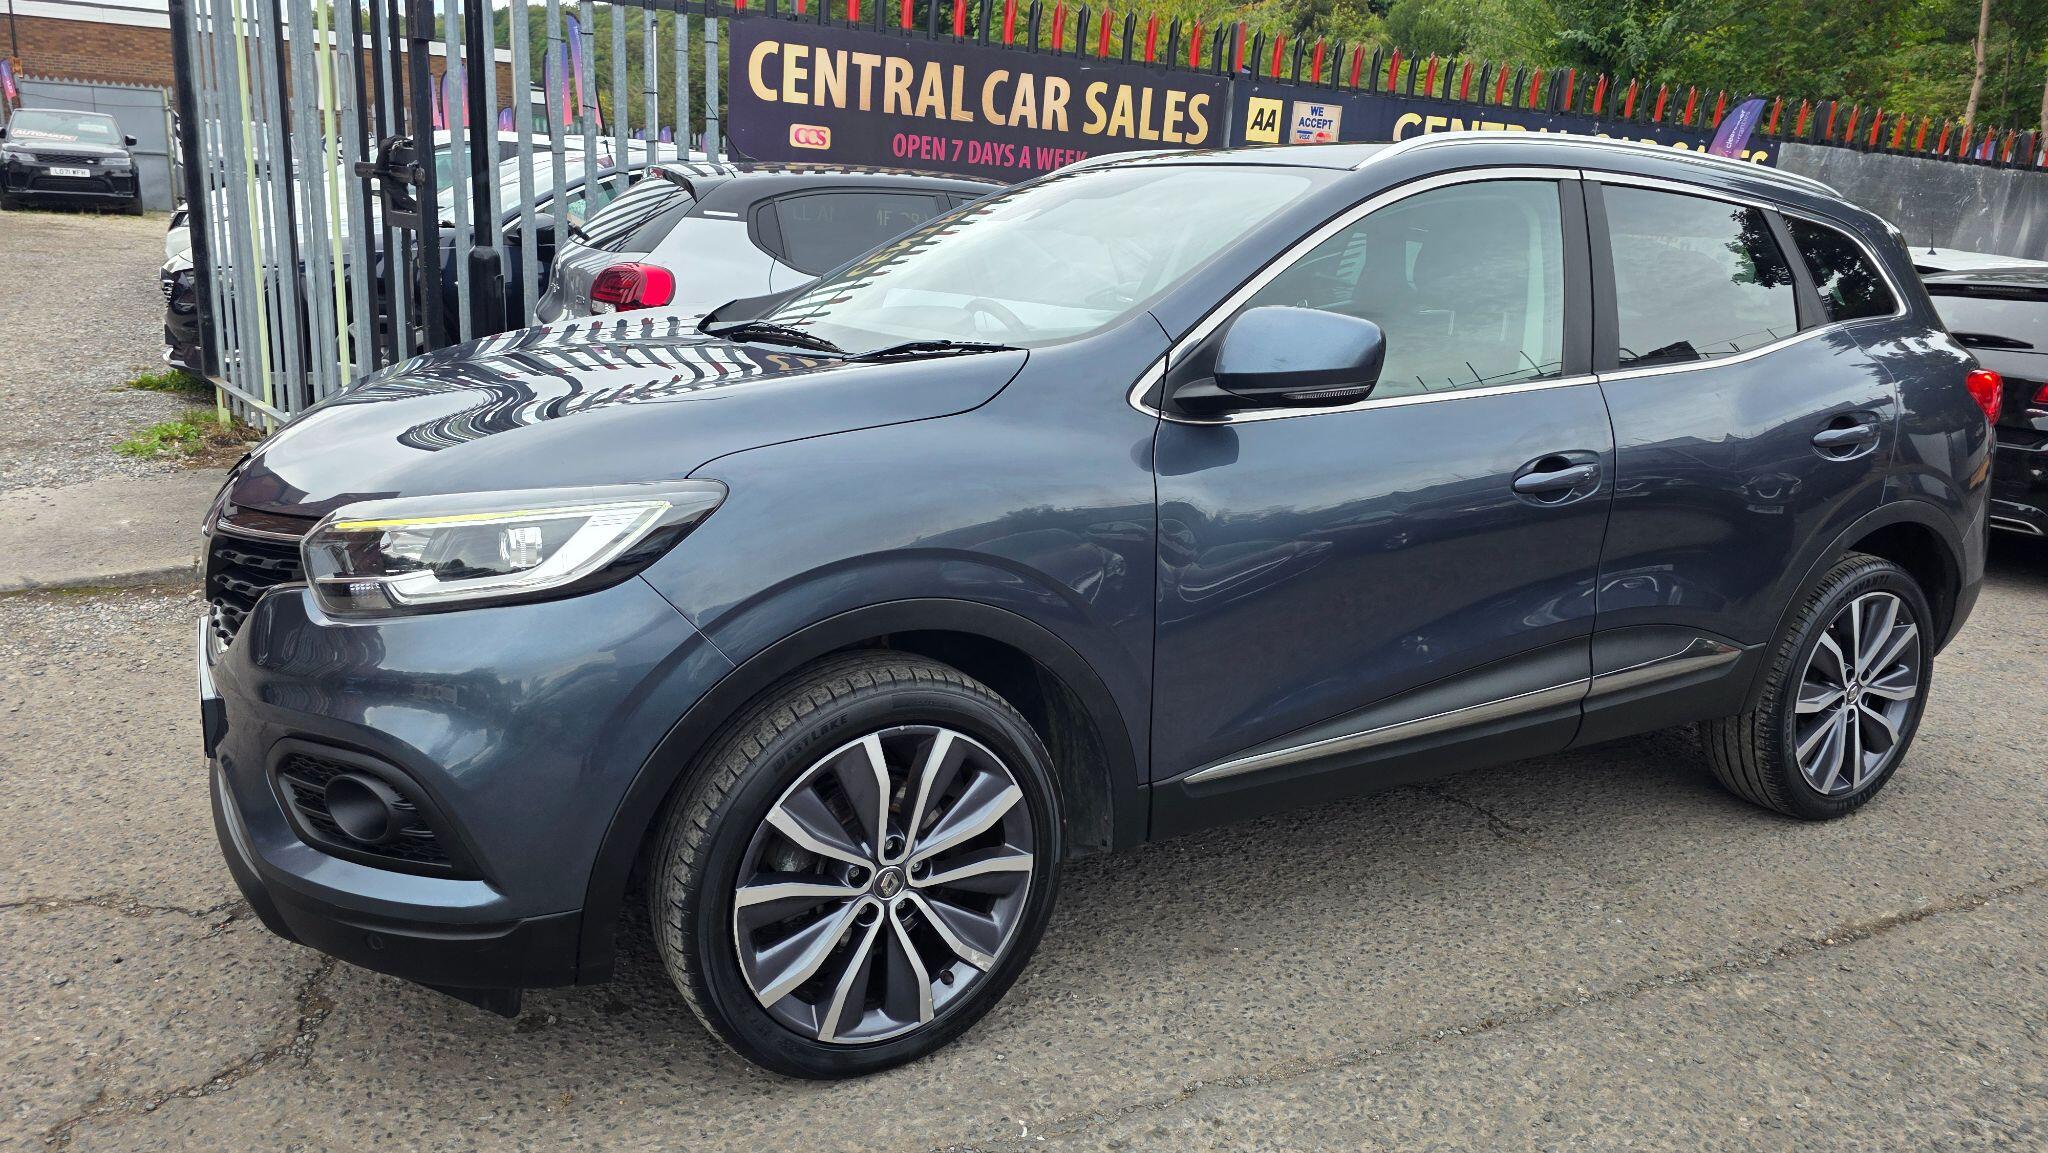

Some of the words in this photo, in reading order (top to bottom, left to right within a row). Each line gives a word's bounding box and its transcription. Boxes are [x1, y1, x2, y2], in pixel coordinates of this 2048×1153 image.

[748, 40, 974, 122] CENTRAL
[981, 69, 1071, 132] CAR
[1082, 81, 1210, 145] SALES
[1250, 107, 1277, 132] AA
[1310, 105, 1324, 117] WE
[1298, 116, 1334, 130] ACCEPT
[794, 127, 827, 147] CCS
[892, 133, 946, 161] OPEN
[951, 139, 963, 162] 7
[967, 140, 1015, 168] DAYS
[1018, 145, 1031, 169] A
